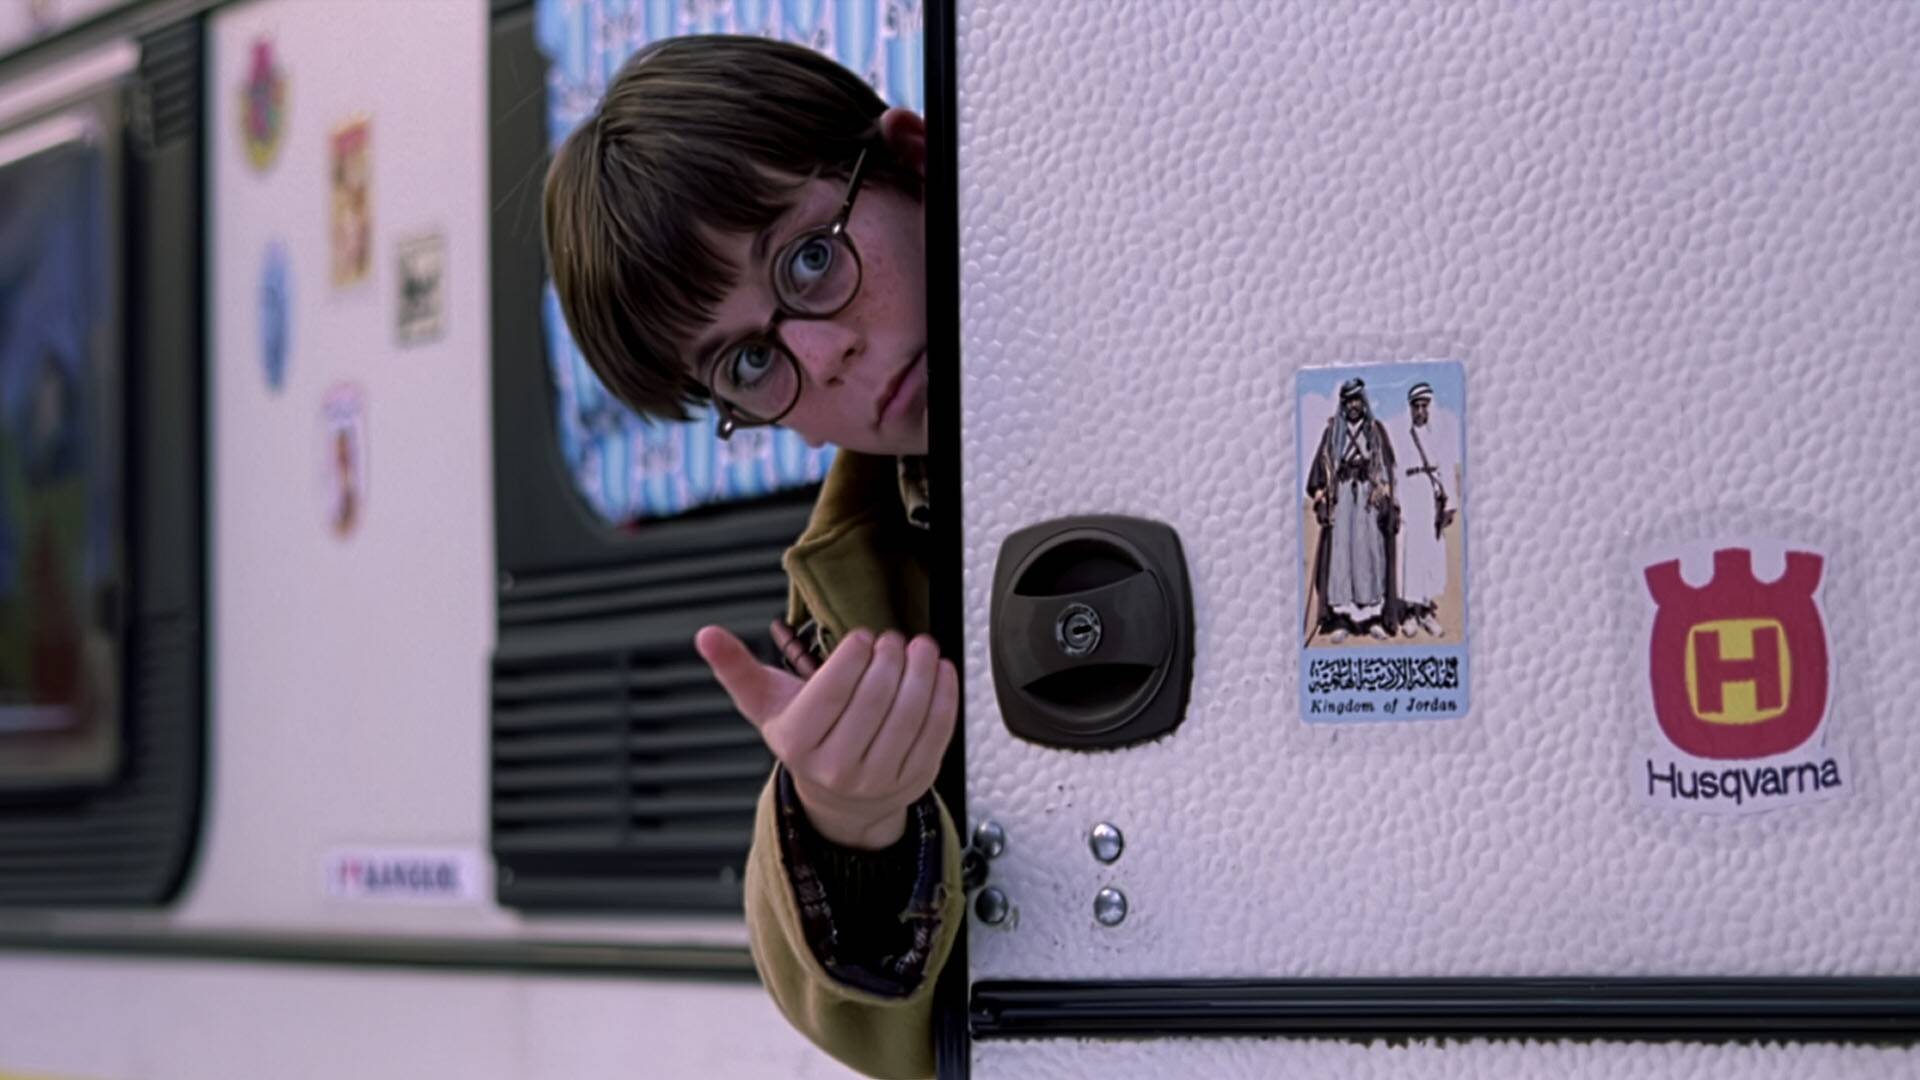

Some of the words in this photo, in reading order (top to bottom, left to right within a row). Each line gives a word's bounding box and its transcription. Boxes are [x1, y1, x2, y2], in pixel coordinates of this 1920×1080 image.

[1693, 626, 1786, 715] H
[1310, 698, 1375, 716] Kingdom
[1383, 697, 1399, 715] of
[1405, 697, 1458, 713] Jordan
[1647, 758, 1842, 805] Husqvarna
